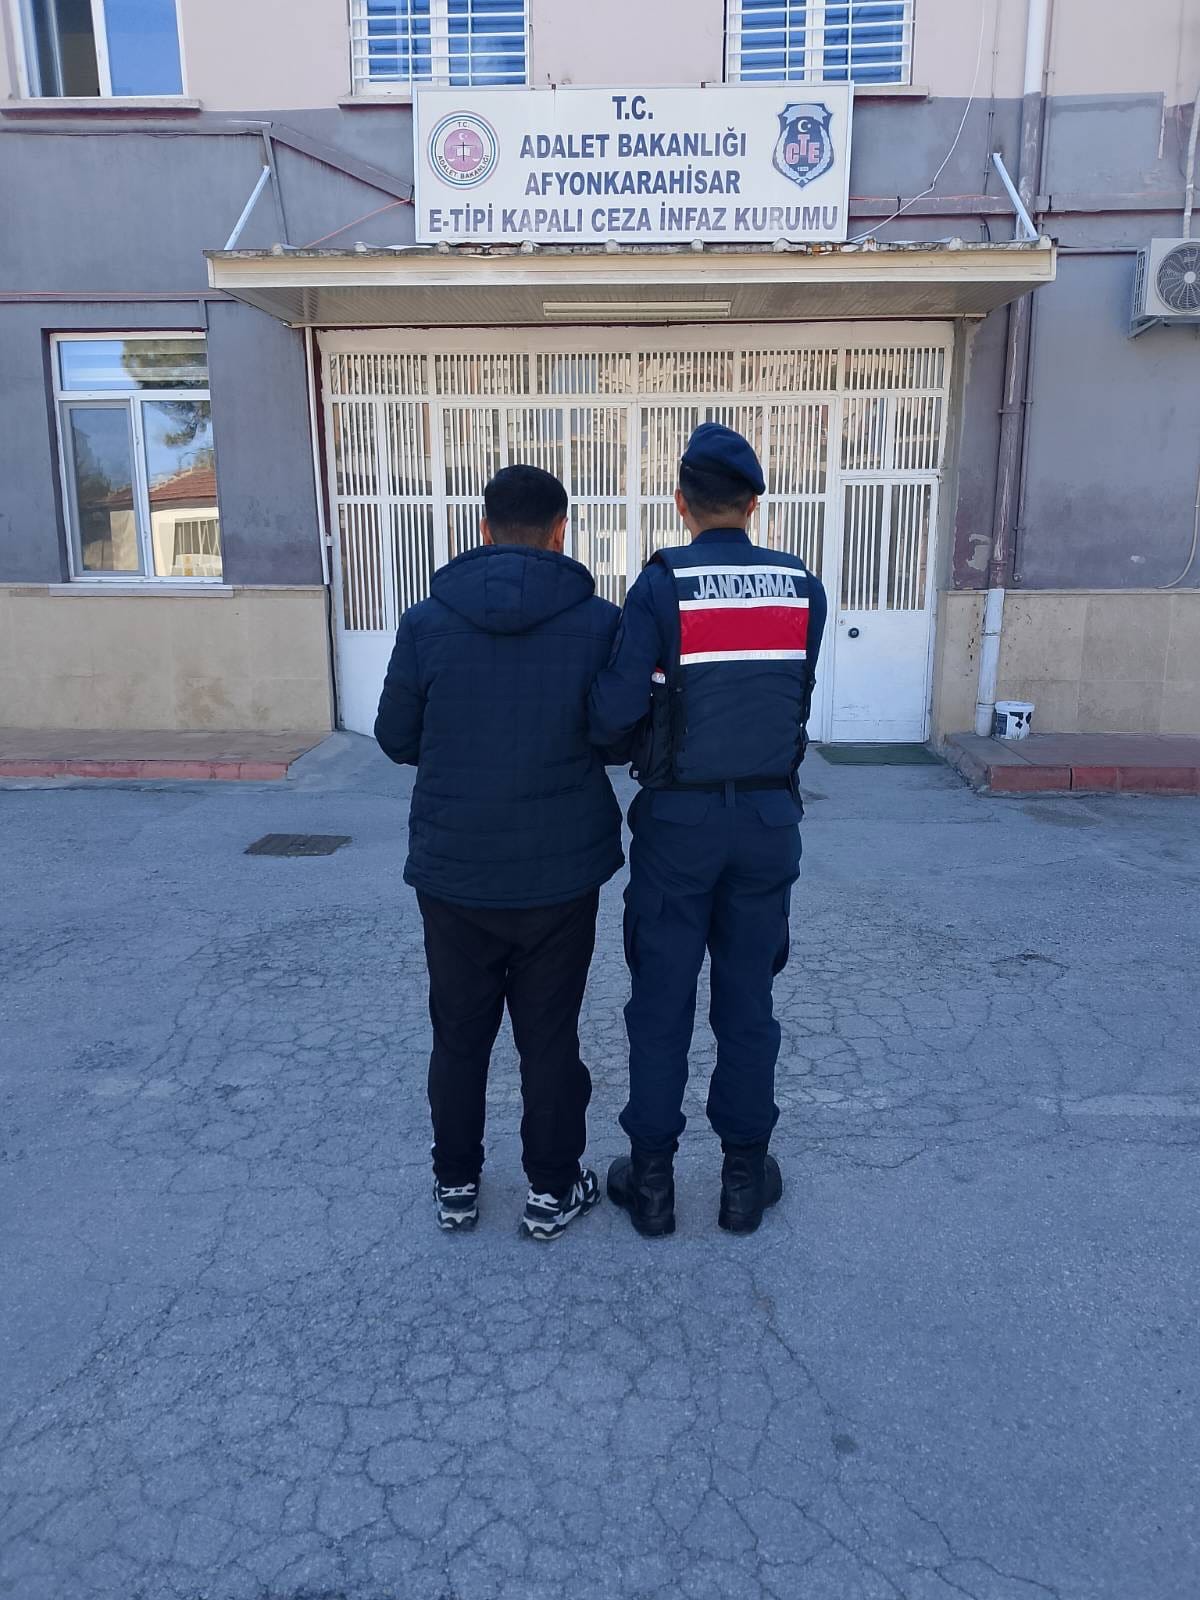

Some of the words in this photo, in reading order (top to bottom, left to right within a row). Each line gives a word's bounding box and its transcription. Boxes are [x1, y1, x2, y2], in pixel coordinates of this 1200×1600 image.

[612, 95, 654, 120] T.C.
[519, 133, 610, 158] ADALET
[618, 127, 747, 157] BAKANLIĞI
[785, 133, 820, 164] CTE
[437, 155, 459, 177] ADALET
[525, 164, 741, 195] AFYONKARAHİSAR
[429, 203, 493, 232] E-TİPİ
[501, 208, 583, 232] KAPALI
[591, 207, 652, 231] CEZA
[660, 202, 726, 231] İNFAZ
[734, 206, 838, 230] KURUMU
[693, 574, 797, 599] JANDARMA
